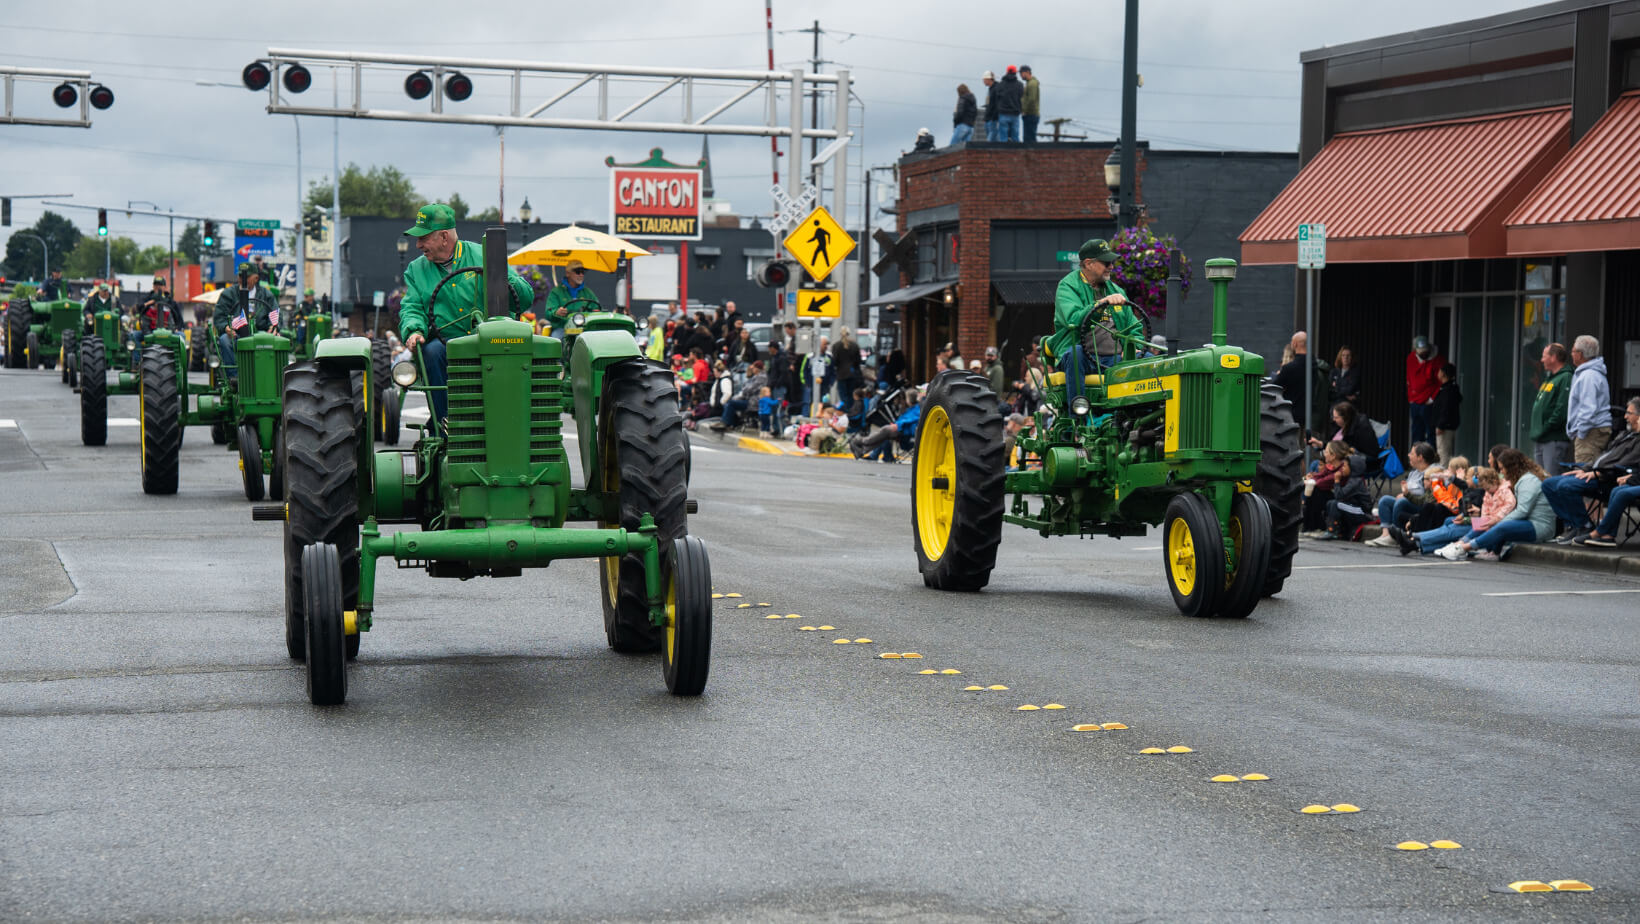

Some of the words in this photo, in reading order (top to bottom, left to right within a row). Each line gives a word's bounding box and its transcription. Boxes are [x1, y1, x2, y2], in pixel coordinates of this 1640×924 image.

[619, 177, 694, 208] CANTON
[770, 187, 816, 233] CROSSING
[617, 217, 696, 233] RESTAURANT
[1300, 226, 1307, 239] 2
[1134, 383, 1146, 392] JOHN
